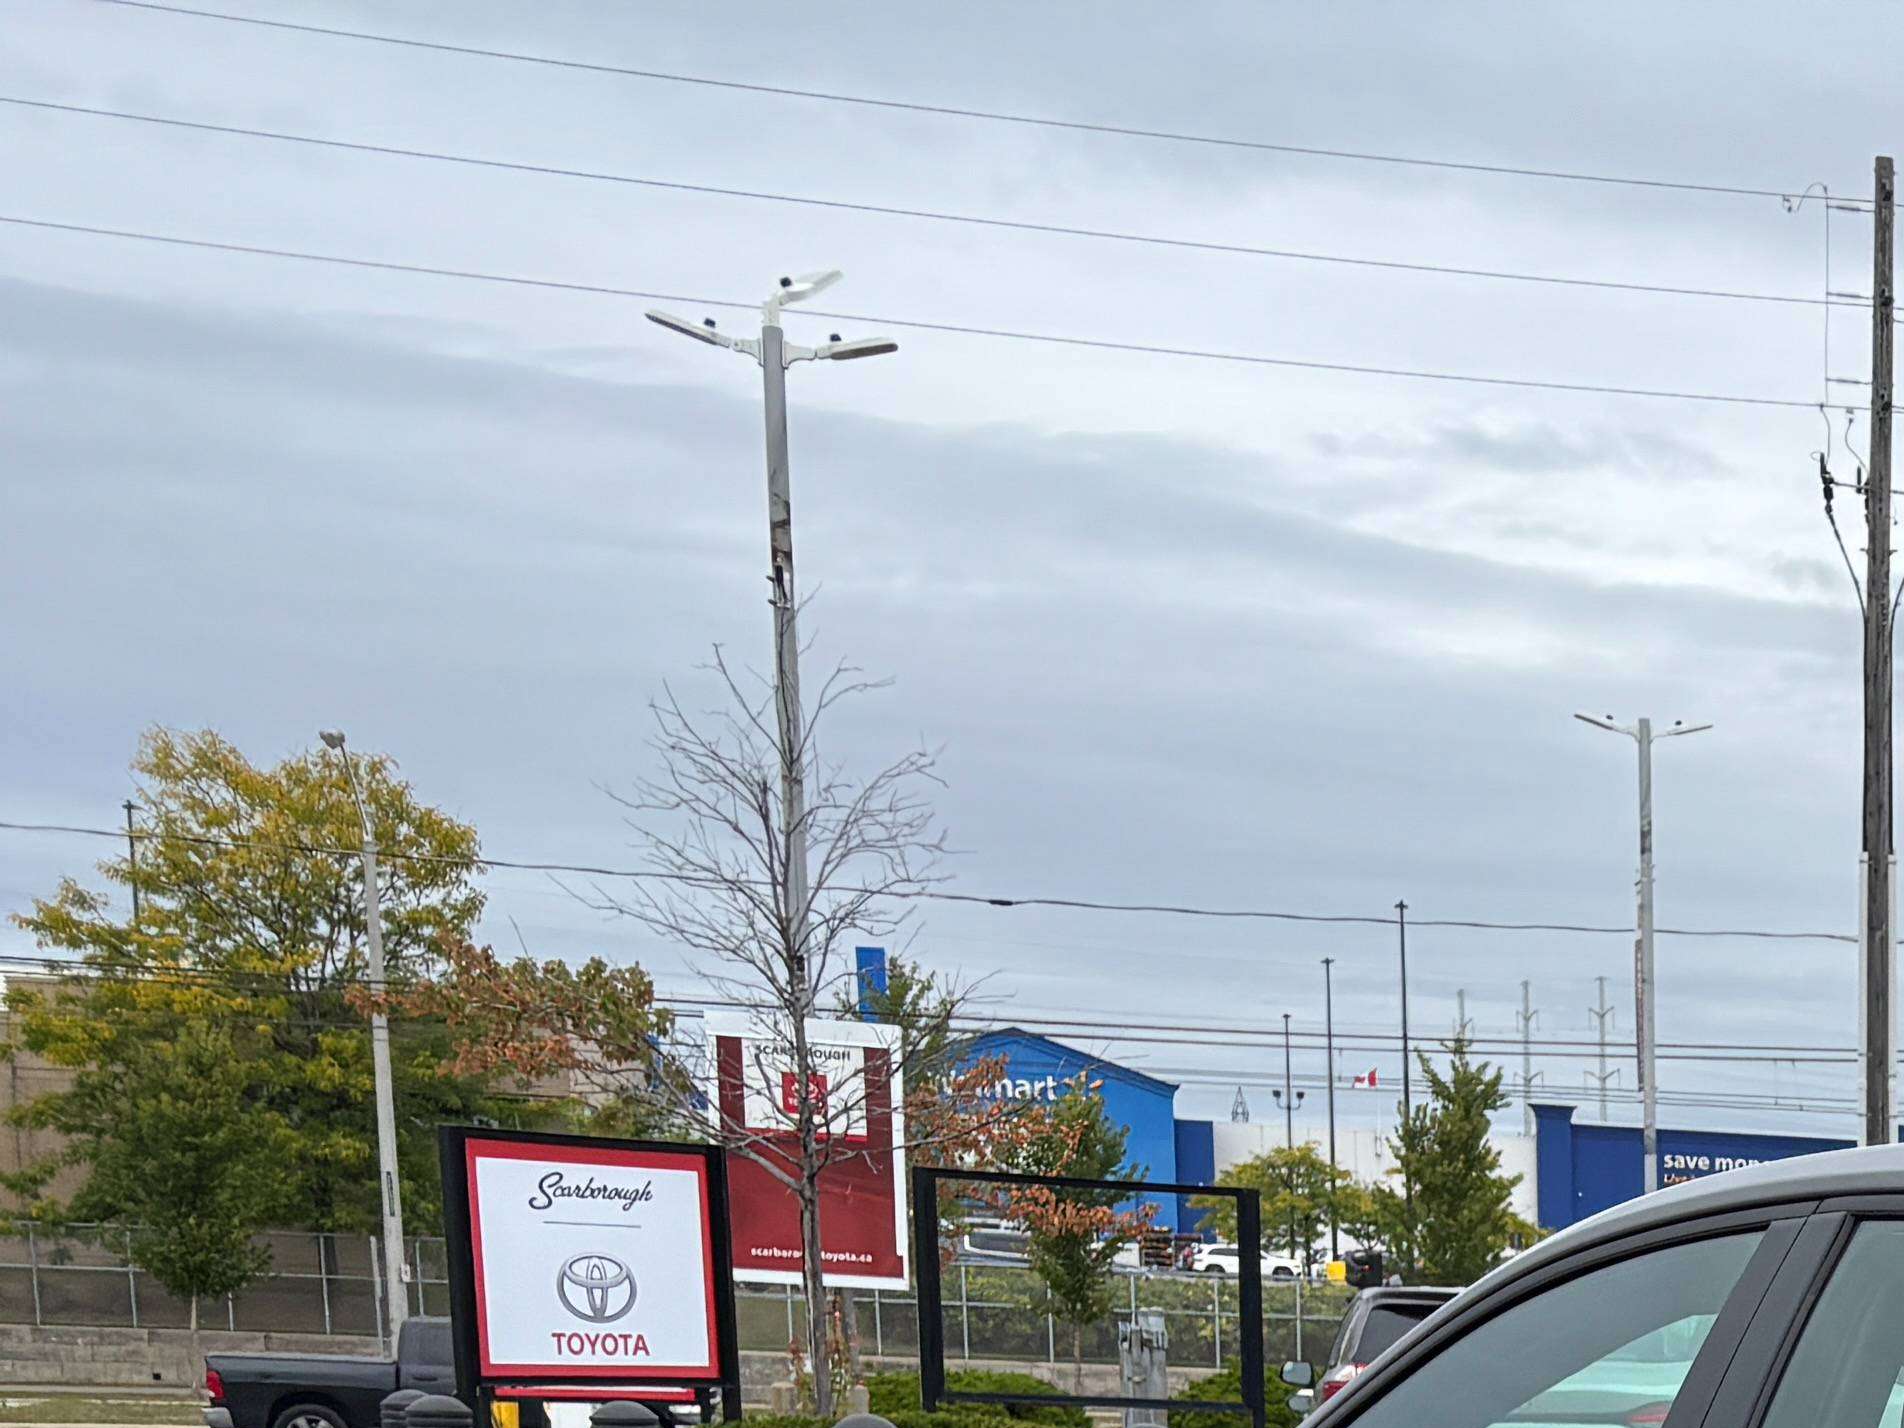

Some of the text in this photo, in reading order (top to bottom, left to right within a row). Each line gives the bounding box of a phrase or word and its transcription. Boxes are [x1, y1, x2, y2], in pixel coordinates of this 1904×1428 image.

[1664, 1153, 1710, 1171] save
[528, 1171, 653, 1211] Scarborough
[551, 1332, 651, 1356] TOYOTA
